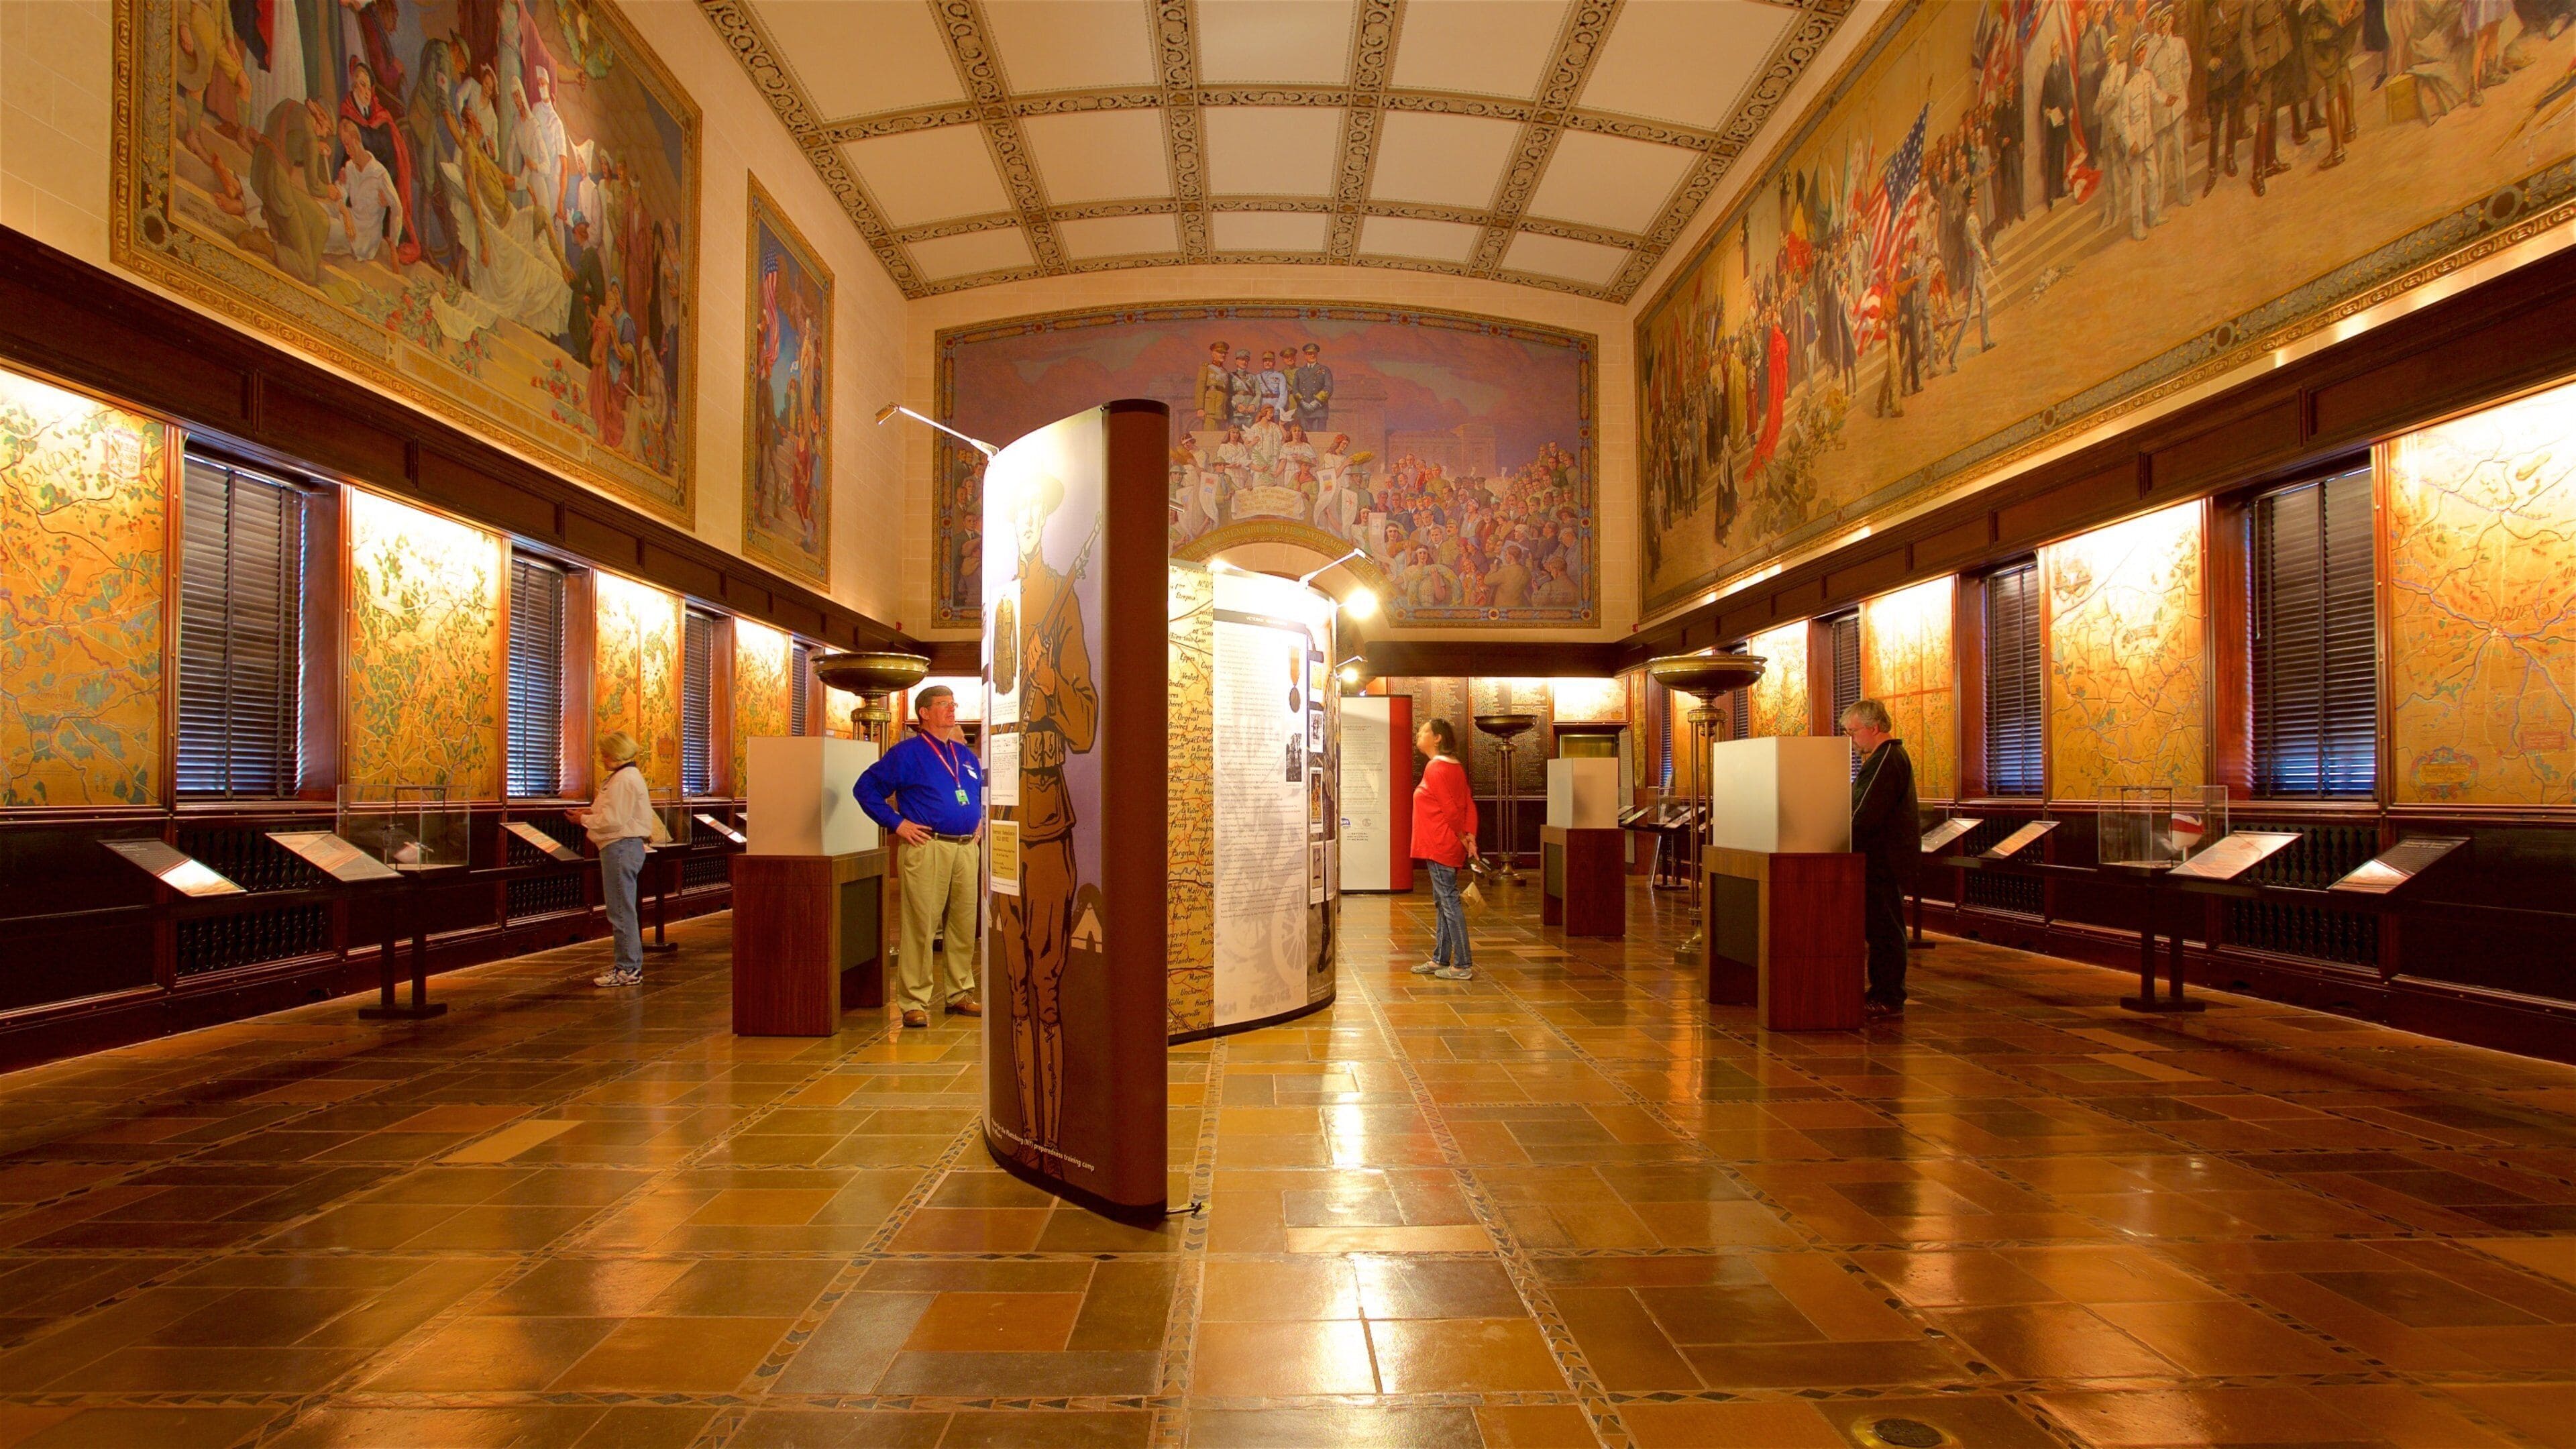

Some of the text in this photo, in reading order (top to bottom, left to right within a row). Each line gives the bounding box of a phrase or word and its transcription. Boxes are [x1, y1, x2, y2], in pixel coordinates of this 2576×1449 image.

[1222, 524, 1272, 540] MEMORIAL
[1273, 524, 1296, 535] SITE
[1305, 529, 1351, 554] NOVEMBE
[1033, 1143, 1063, 1160] preparedness
[1063, 1152, 1081, 1169] training
[1081, 1161, 1095, 1173] camp
